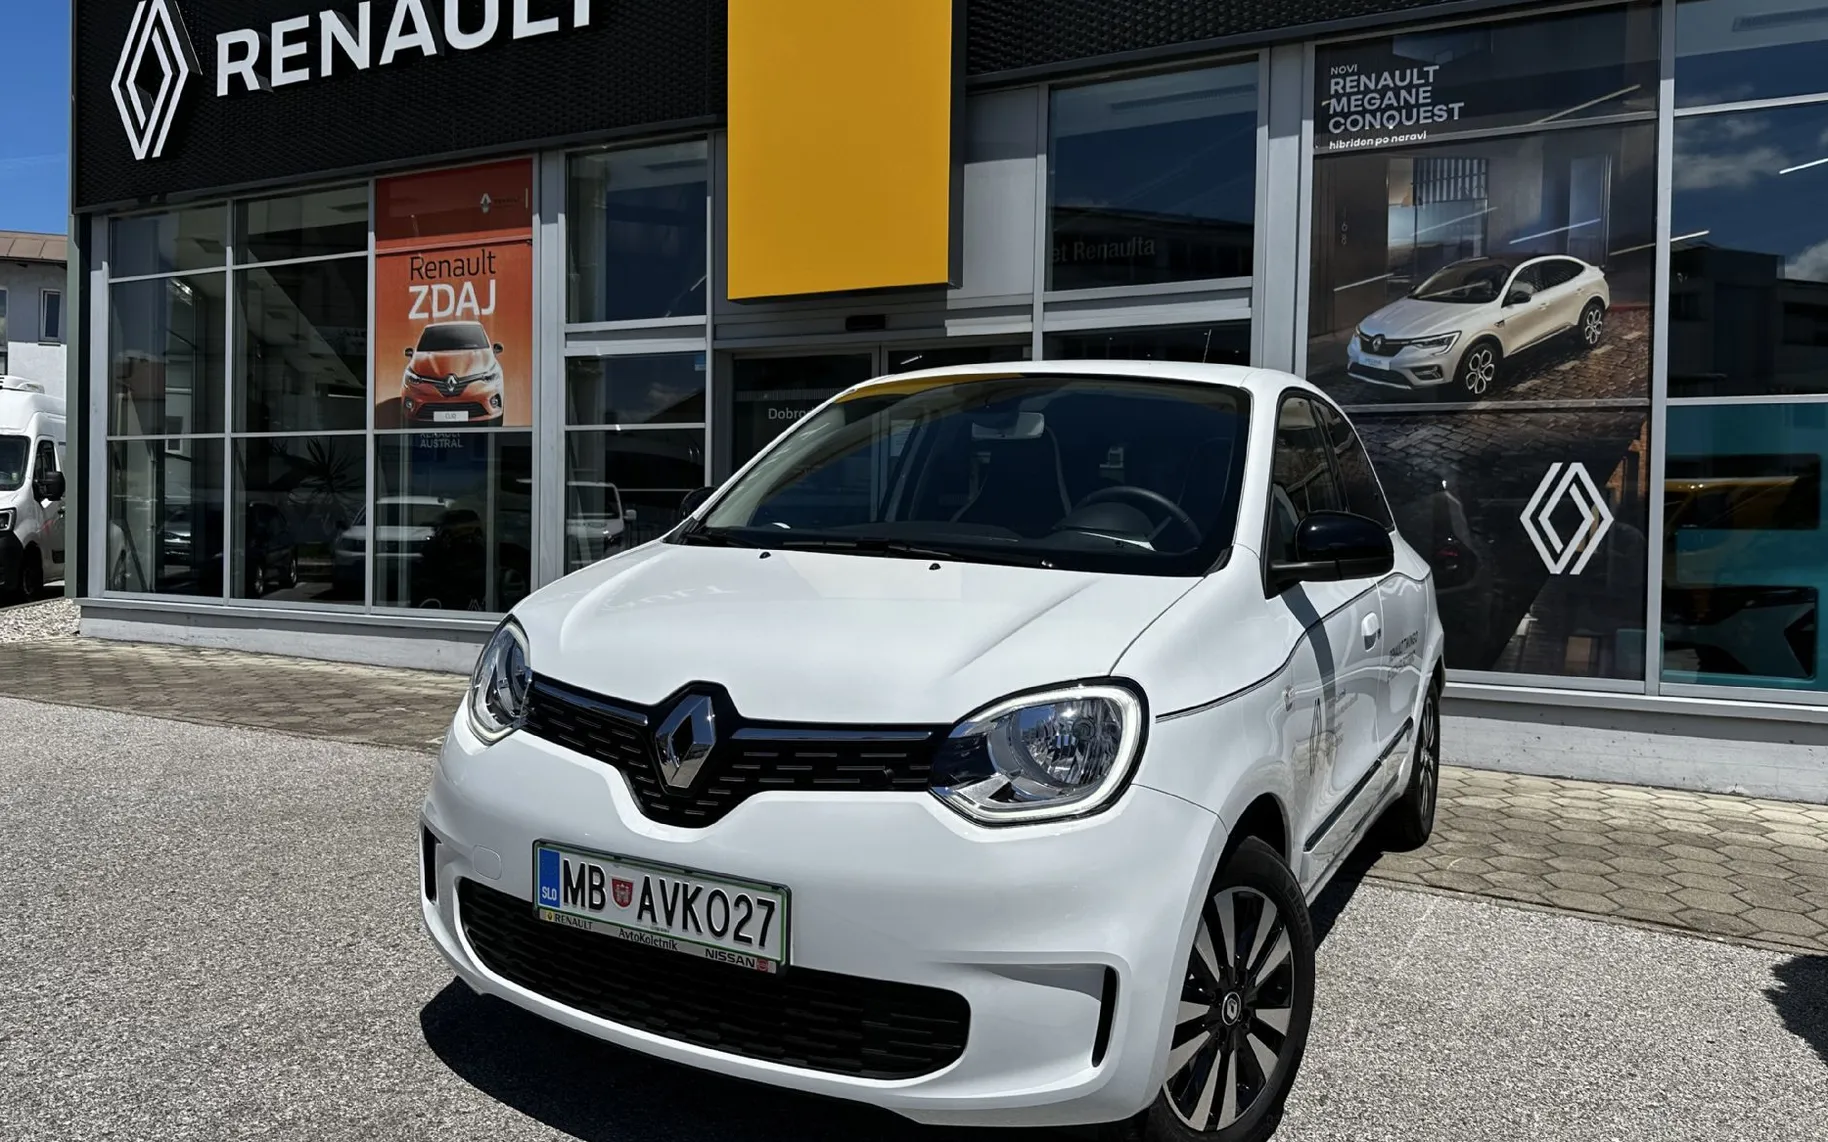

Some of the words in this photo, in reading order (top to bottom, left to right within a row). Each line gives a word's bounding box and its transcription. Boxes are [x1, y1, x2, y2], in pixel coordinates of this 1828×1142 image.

[1330, 64, 1358, 75] NOVI
[1330, 65, 1440, 95] RENAULT
[1329, 86, 1432, 114] MEGANE
[1328, 102, 1465, 134] CONQUEST
[1375, 137, 1389, 147] po
[1391, 130, 1427, 143] naravi
[1073, 236, 1156, 260] Renaulta
[410, 249, 496, 280] Renault
[408, 279, 496, 319] ZDAJ
[768, 406, 816, 419] Dobro
[420, 439, 464, 449] AUSTRAL
[541, 886, 558, 901] SLO
[563, 858, 606, 911] MB
[554, 913, 593, 930] RENAULT
[618, 928, 678, 951] AvtoKoletnik
[705, 948, 756, 968] NISSAN
